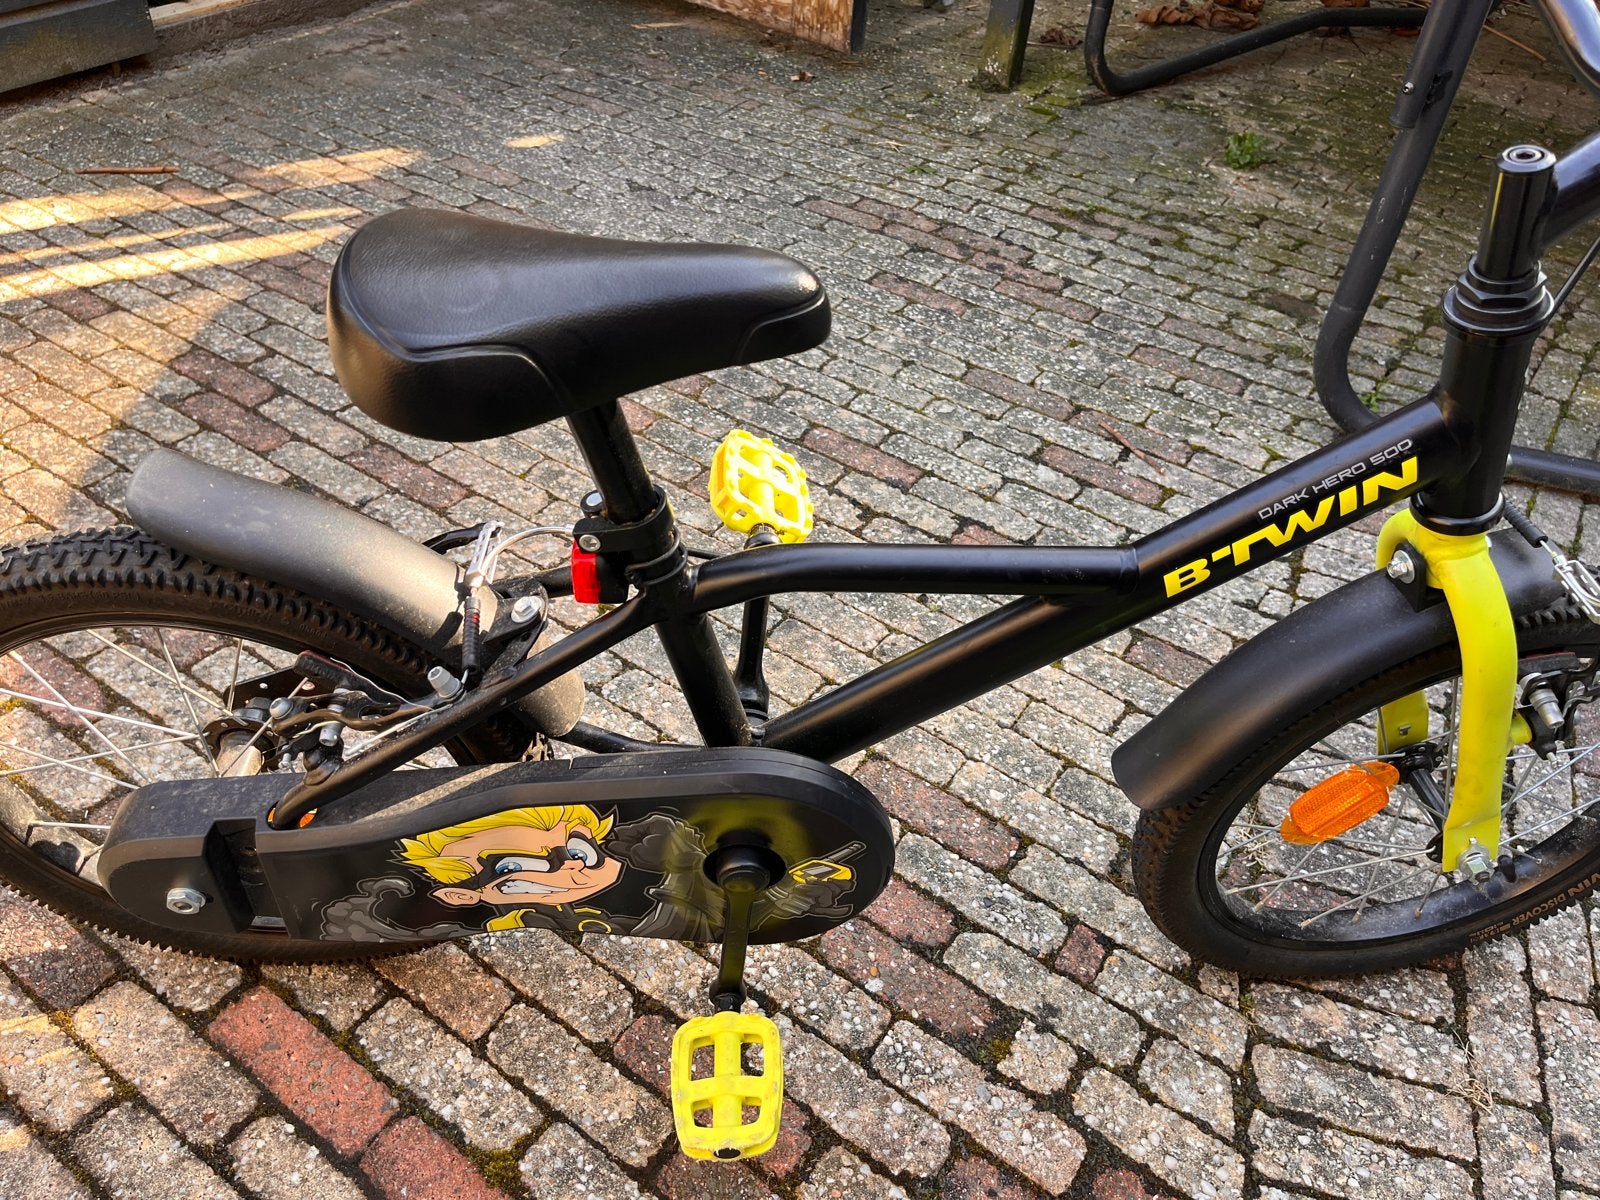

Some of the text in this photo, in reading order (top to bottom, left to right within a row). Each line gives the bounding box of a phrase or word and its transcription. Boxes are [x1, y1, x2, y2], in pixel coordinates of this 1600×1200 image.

[1258, 438, 1413, 520] DARK HERO 500
[1512, 893, 1566, 926] DISCOVER
